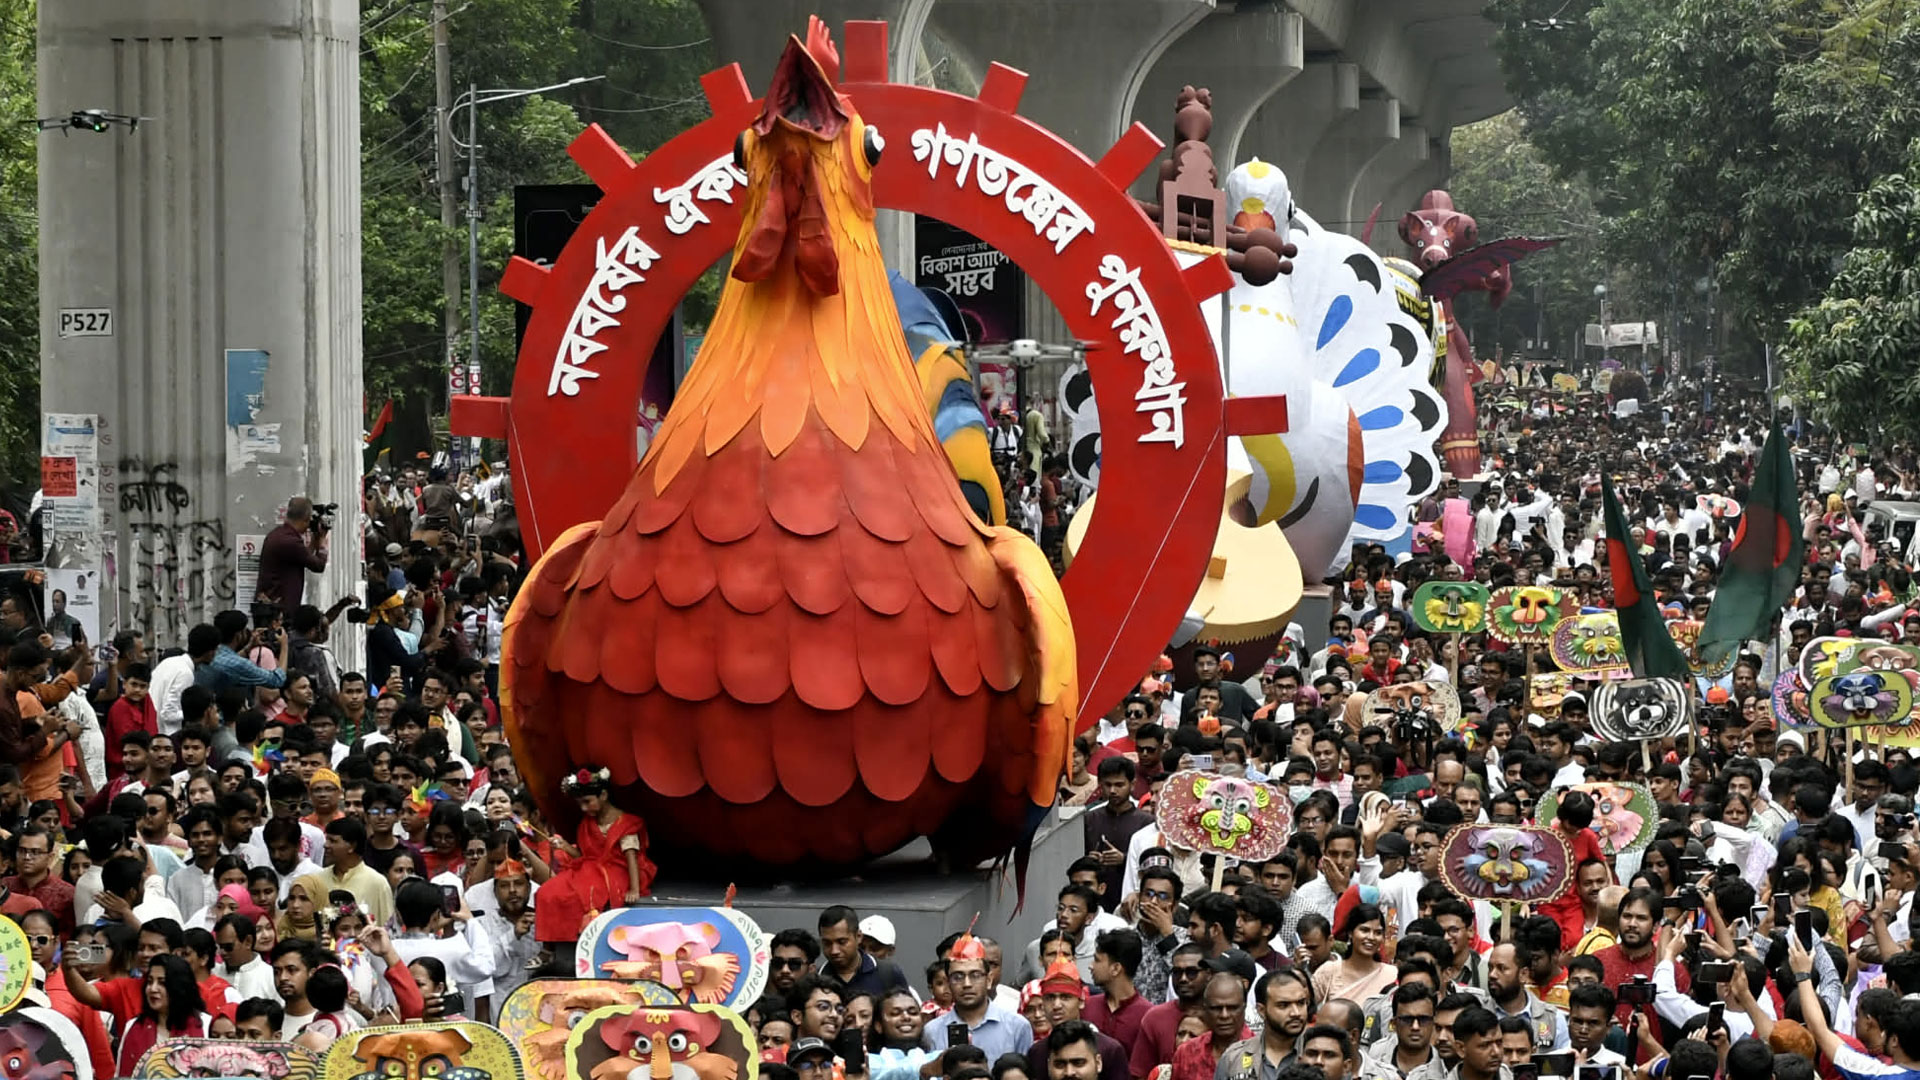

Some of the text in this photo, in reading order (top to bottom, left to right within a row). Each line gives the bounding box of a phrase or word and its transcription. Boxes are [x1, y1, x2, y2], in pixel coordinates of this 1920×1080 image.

[547, 225, 661, 397] নববর্ষের
[653, 152, 749, 235] ঐক
[911, 121, 1095, 255] গণতন্ত্রের
[920, 255, 966, 276] বিকাশ
[944, 267, 996, 296] সম্ভব
[61, 313, 110, 331] P527
